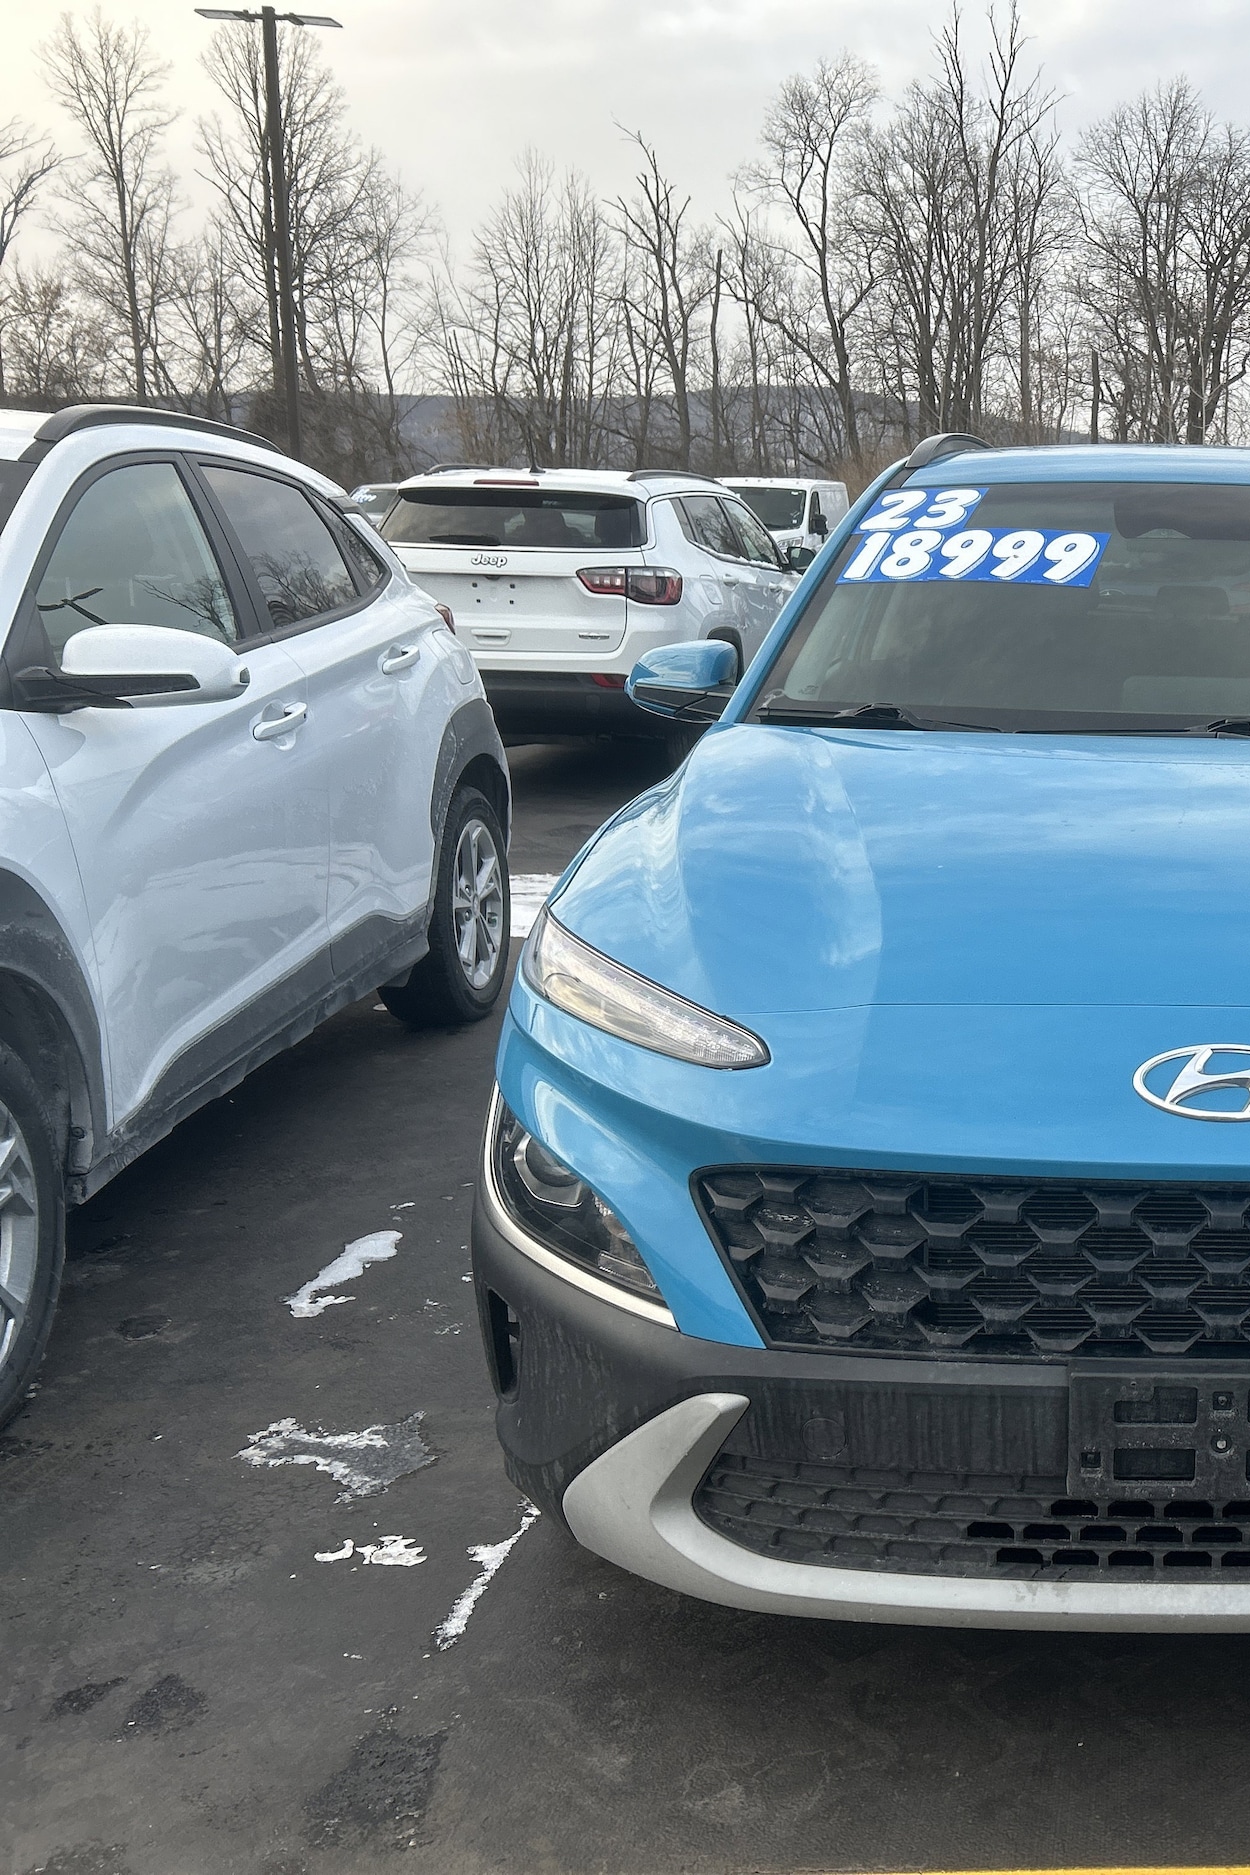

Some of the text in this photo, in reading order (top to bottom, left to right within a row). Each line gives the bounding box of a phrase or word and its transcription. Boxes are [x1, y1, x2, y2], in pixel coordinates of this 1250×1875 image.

[859, 488, 982, 531] 23
[471, 553, 508, 568] Jeep
[842, 529, 1100, 584] 18999
